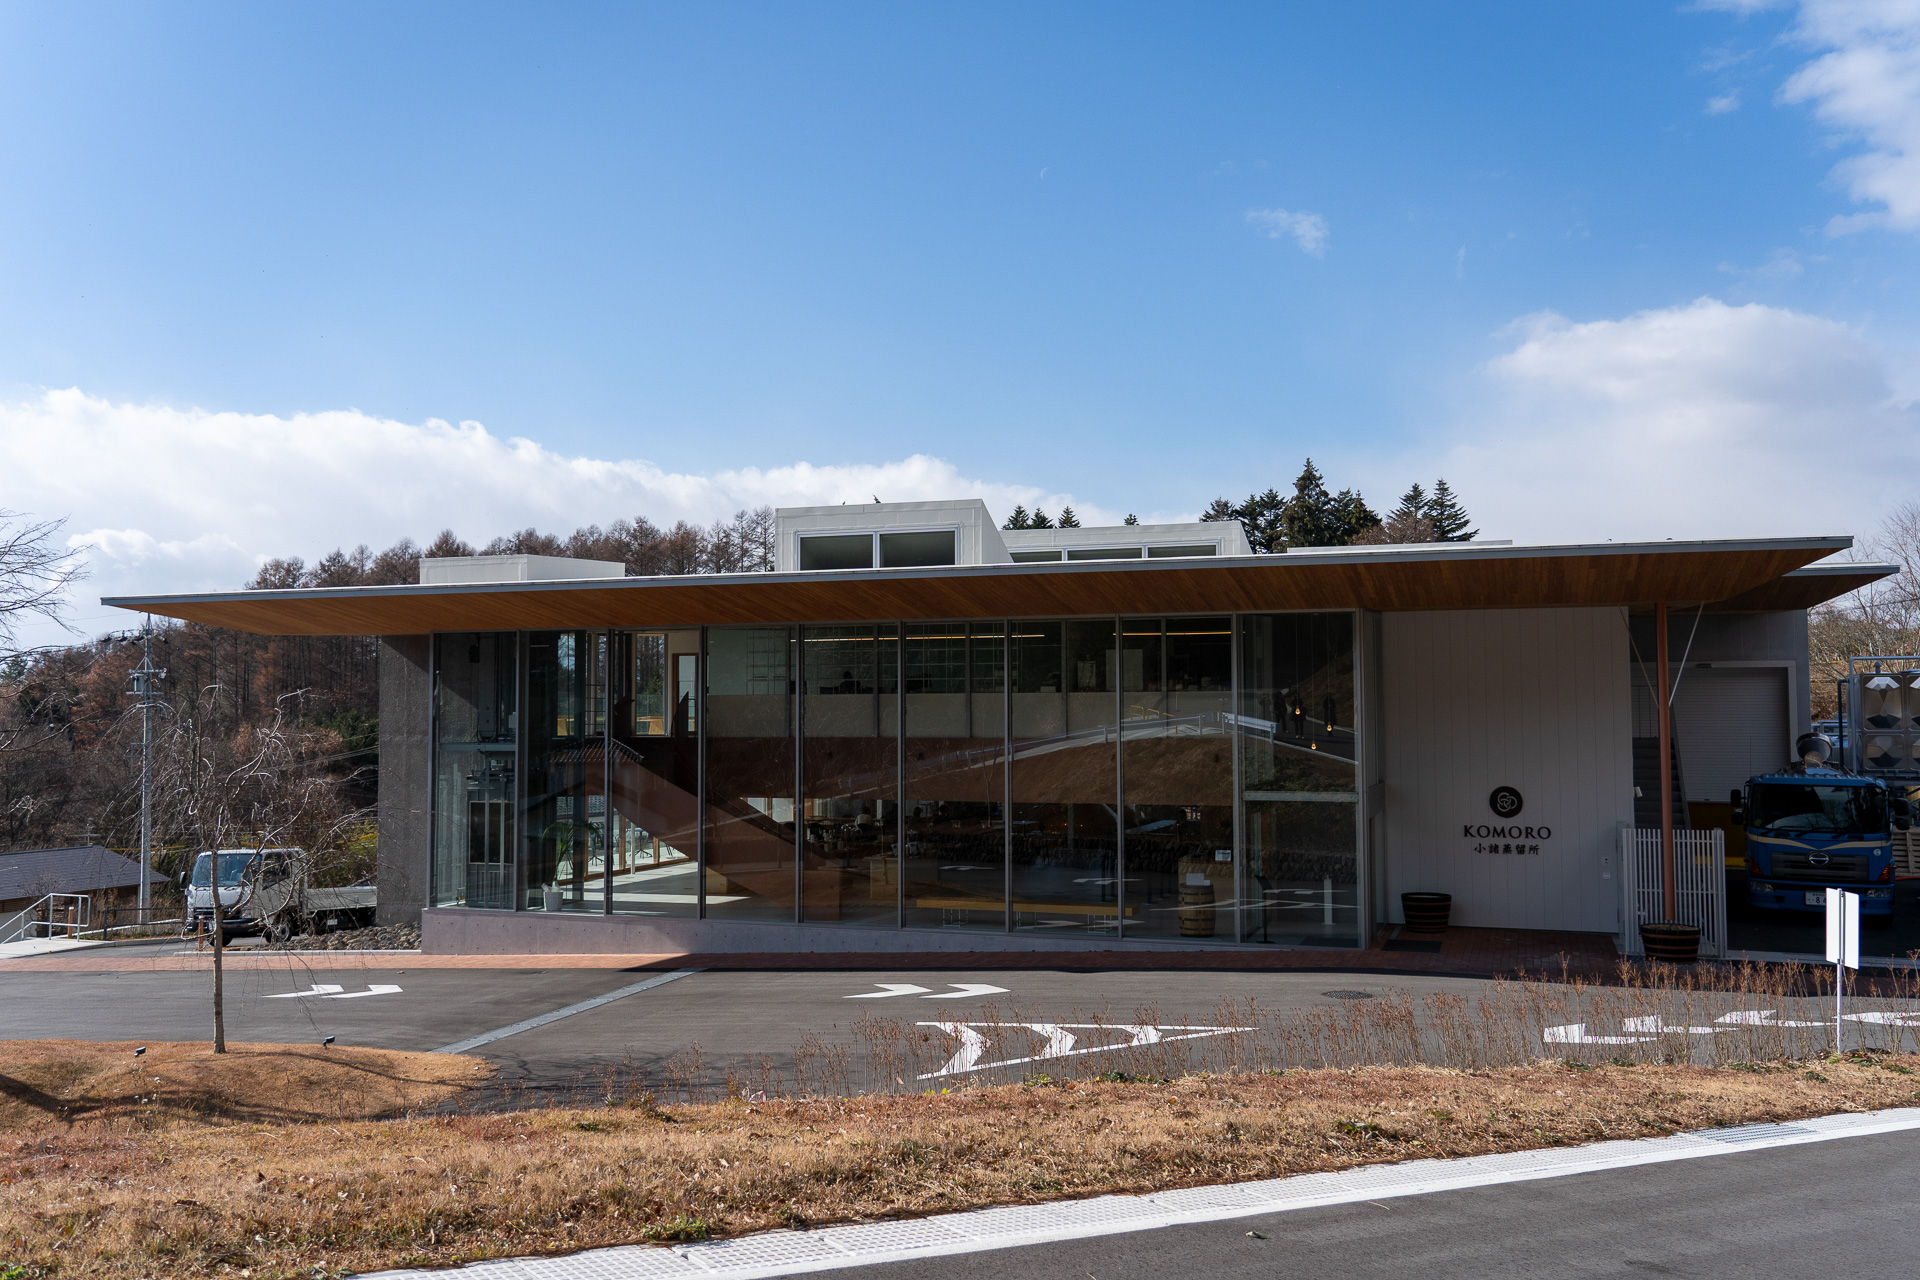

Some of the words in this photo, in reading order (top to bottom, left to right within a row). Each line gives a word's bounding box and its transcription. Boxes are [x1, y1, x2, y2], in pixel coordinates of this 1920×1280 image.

[1463, 825, 1551, 840] KOMORO
[1474, 843, 1540, 855] 小諸蒸留所
